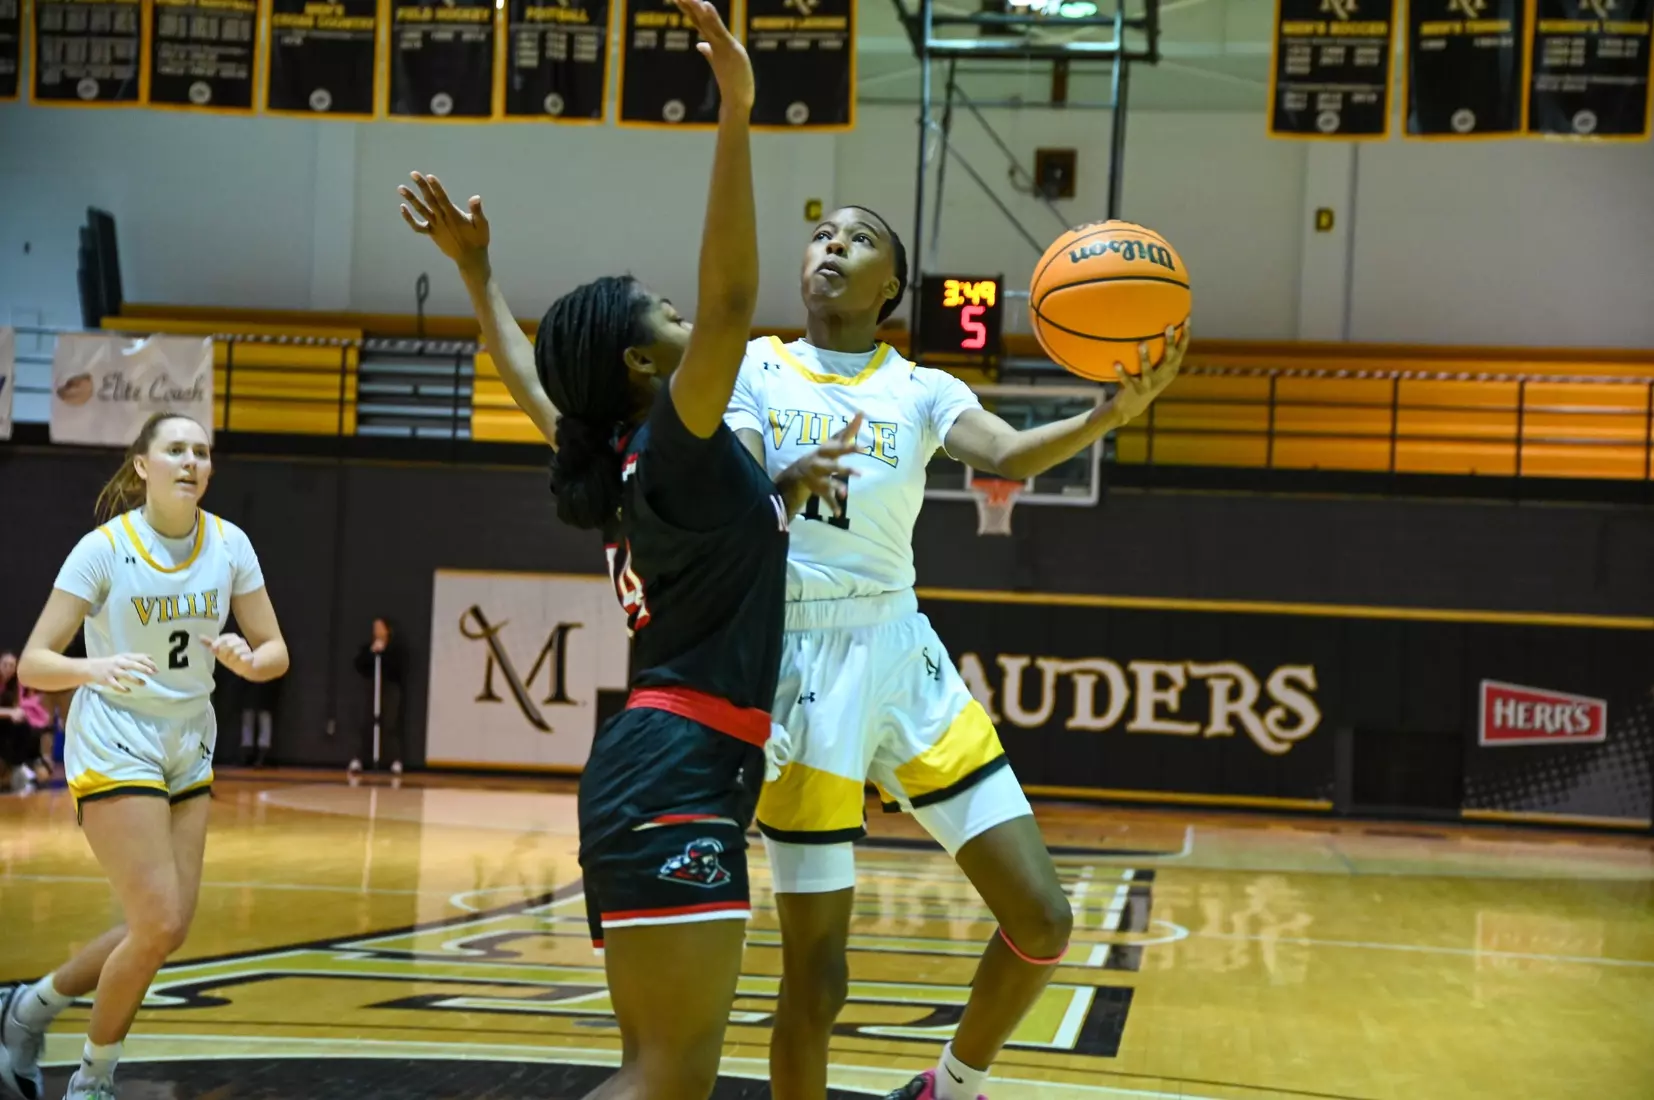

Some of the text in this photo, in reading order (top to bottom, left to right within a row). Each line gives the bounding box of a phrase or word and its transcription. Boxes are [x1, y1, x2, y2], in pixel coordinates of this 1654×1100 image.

[1068, 239, 1175, 271] Wilson
[961, 306, 986, 349] 5
[131, 589, 219, 626] VILLE
[168, 630, 190, 670] 2
[959, 652, 1322, 754] AUDERS
[1493, 698, 1591, 734] HERR'S
